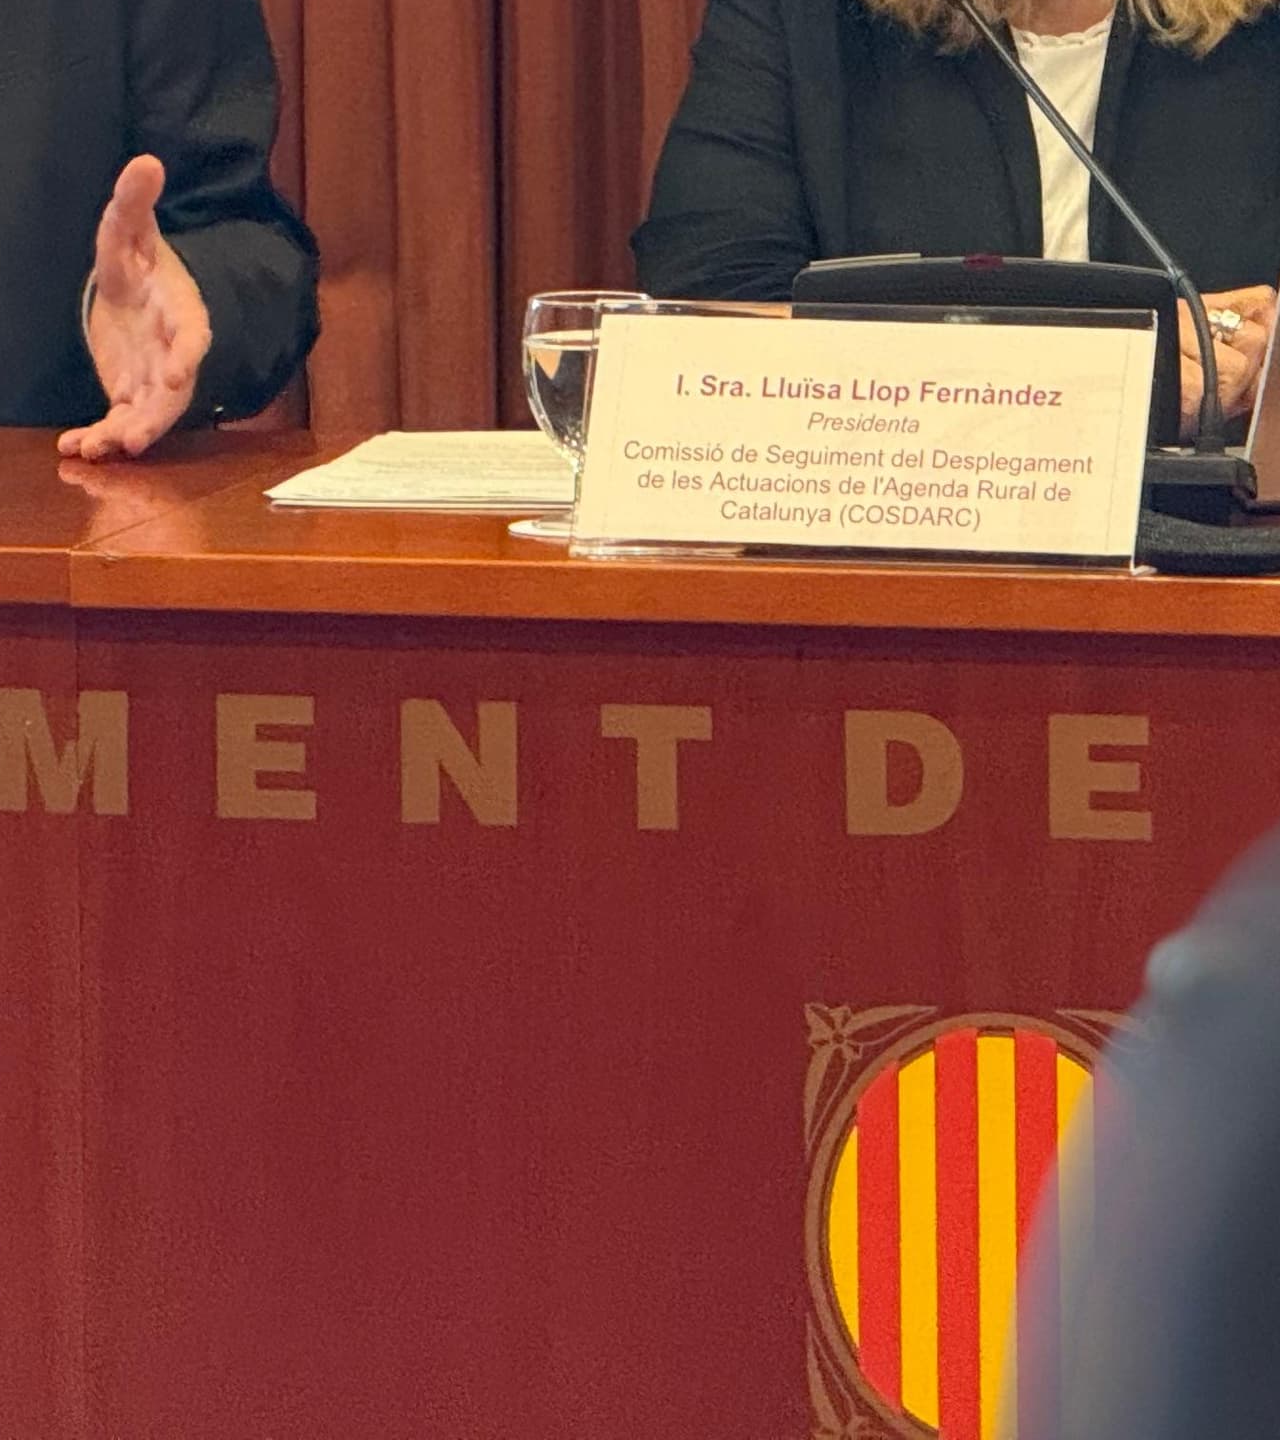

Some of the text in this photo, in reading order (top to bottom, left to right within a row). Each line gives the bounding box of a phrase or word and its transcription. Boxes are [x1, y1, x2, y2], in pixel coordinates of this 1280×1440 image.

[699, 374, 752, 398] Sra.
[761, 375, 842, 400] Lluïsa
[851, 378, 911, 408] Llop
[919, 380, 1064, 407] Fernàndez
[807, 411, 921, 434] Presidenta
[623, 439, 1094, 477] Comissió de Seguiment del Desplegament
[637, 469, 1072, 503] de les Actuacions de l'Agenda Rural de
[720, 499, 981, 532] Catalunya (COSDARC)
[845, 710, 1152, 842] DE
